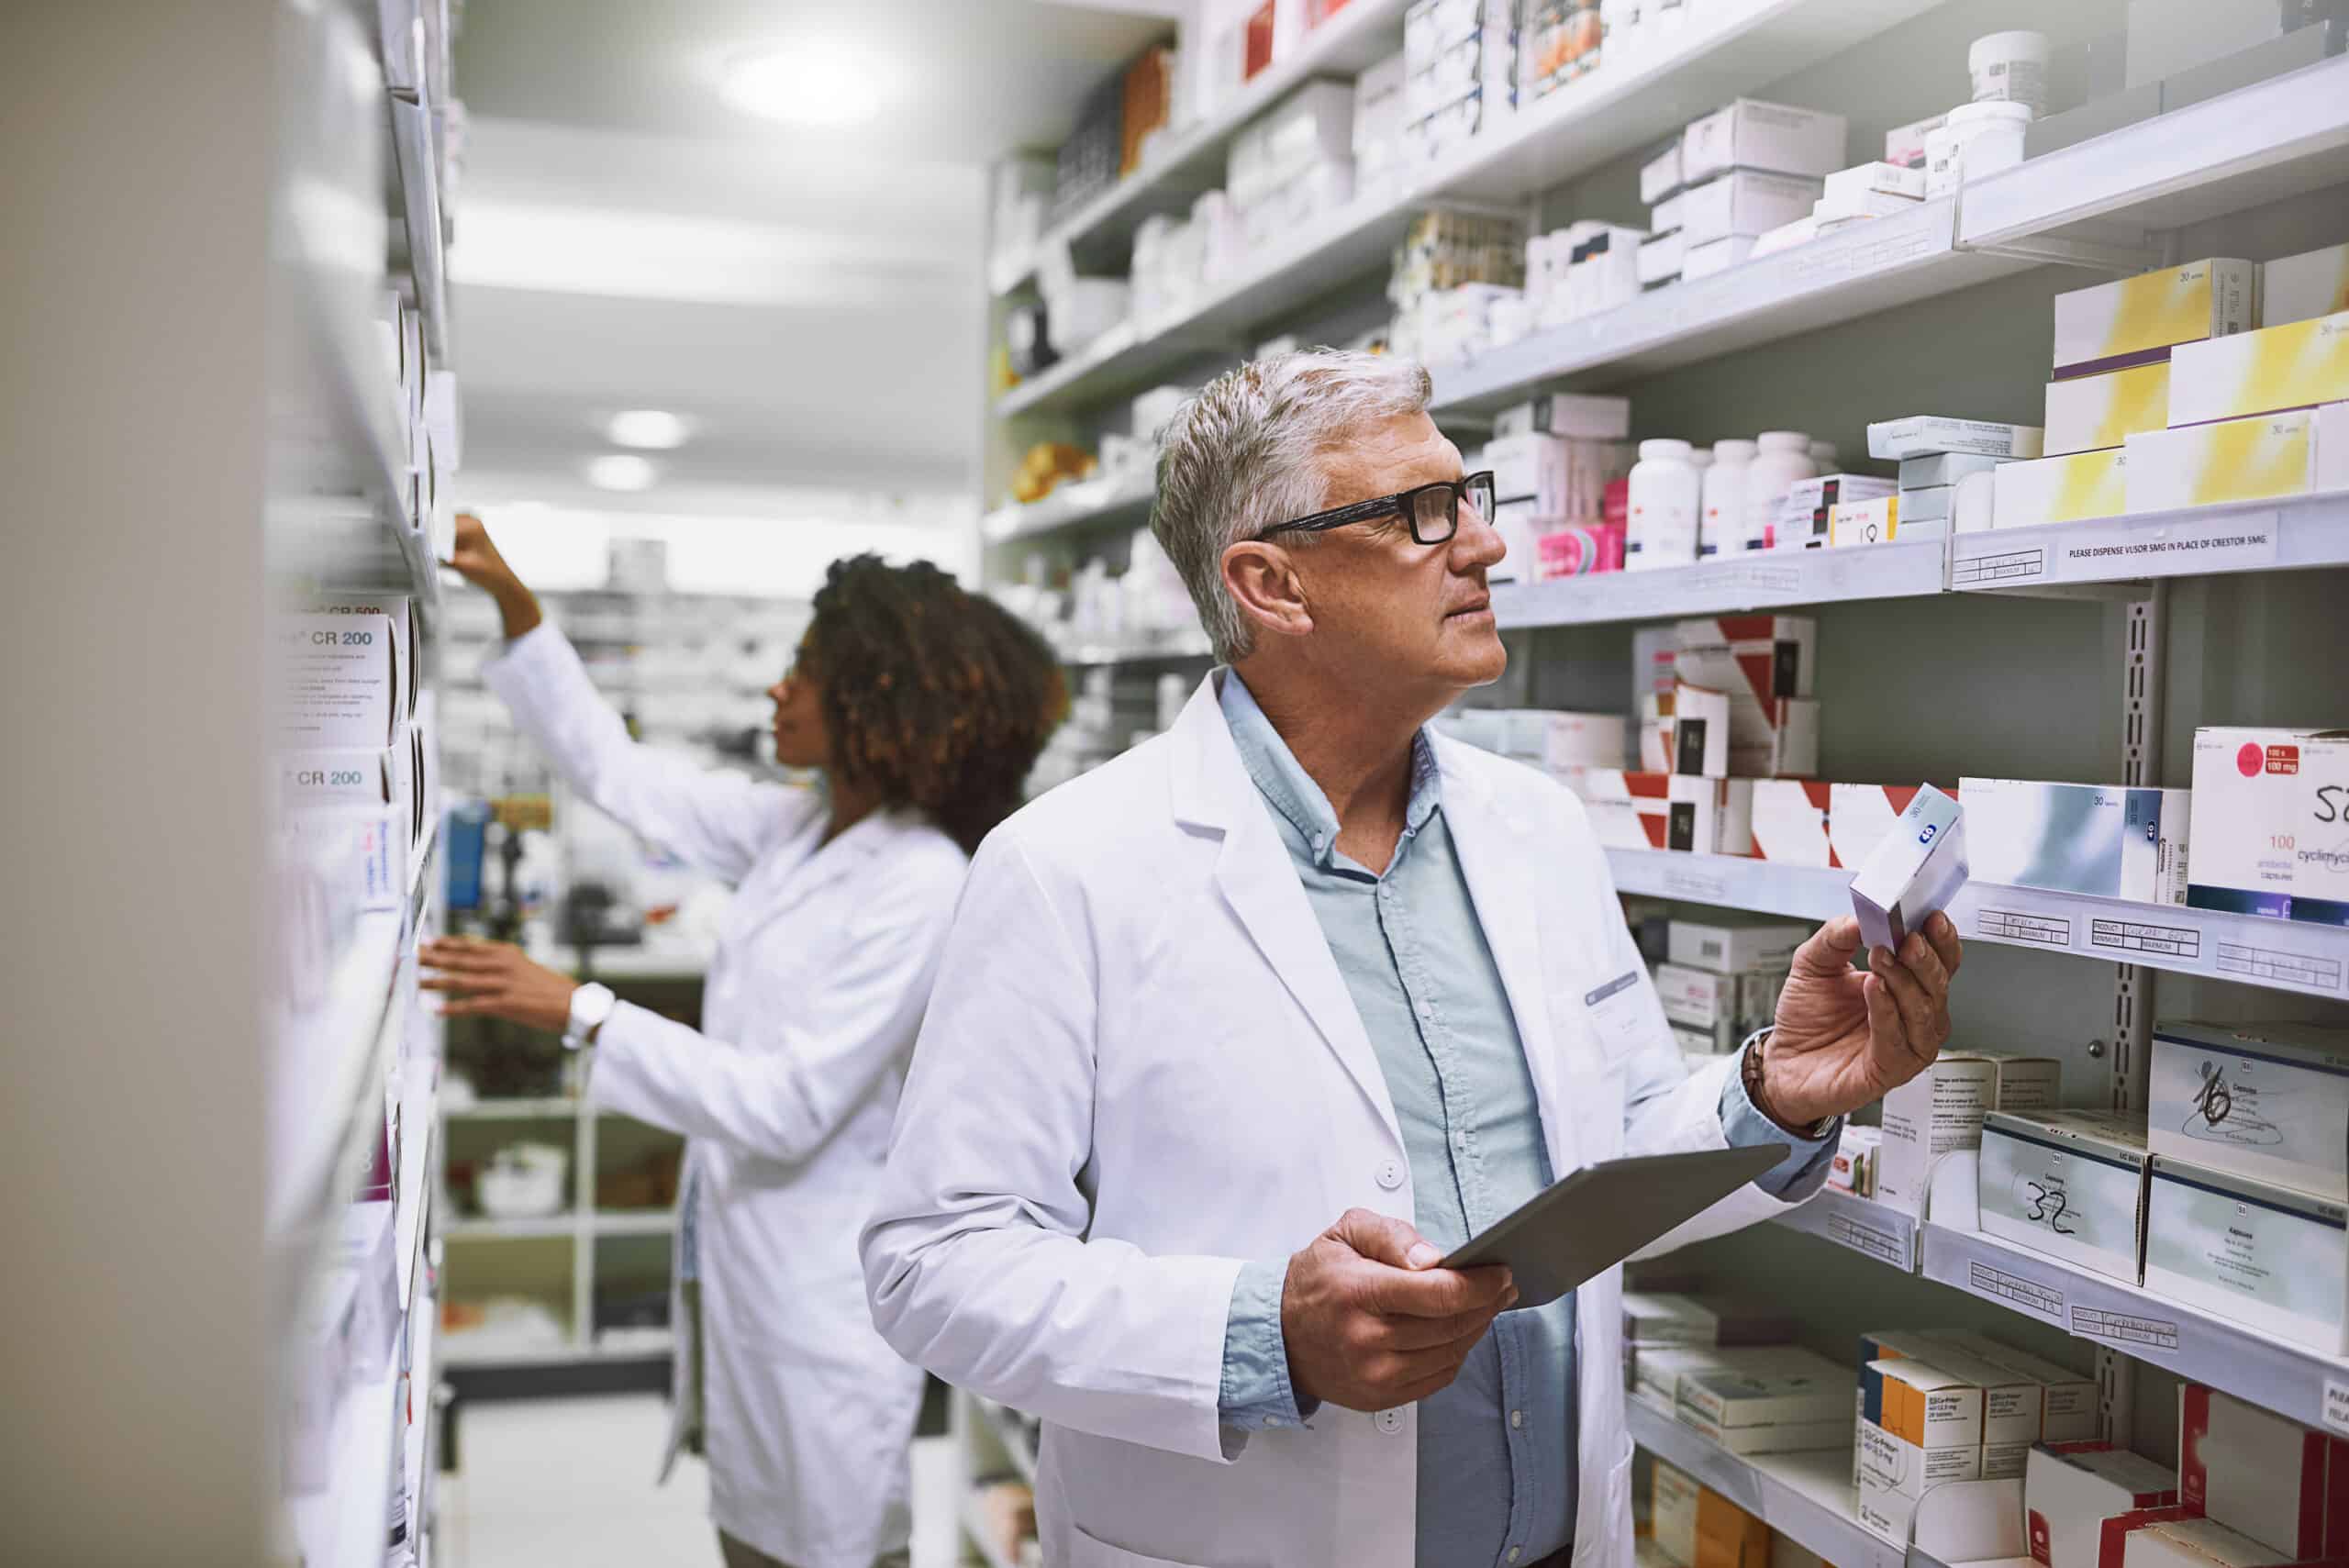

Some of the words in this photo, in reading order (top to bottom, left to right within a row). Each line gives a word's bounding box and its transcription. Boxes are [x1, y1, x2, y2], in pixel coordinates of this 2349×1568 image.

[2069, 548, 2092, 558] PLEASE
[2093, 546, 2124, 557] DISPENSE
[2167, 542, 2176, 550] IN
[2176, 540, 2199, 550] PLACE
[2200, 539, 2210, 549] OF
[2211, 537, 2245, 548] CRESTOR
[312, 631, 338, 646] CR
[342, 631, 373, 646] 200
[2267, 762, 2281, 772] 100
[2283, 763, 2298, 773] mg
[298, 771, 325, 785] CR
[330, 771, 362, 785] 200
[2093, 795, 2104, 806] 30
[2269, 836, 2296, 851] 100
[2027, 1180, 2076, 1235] 32
